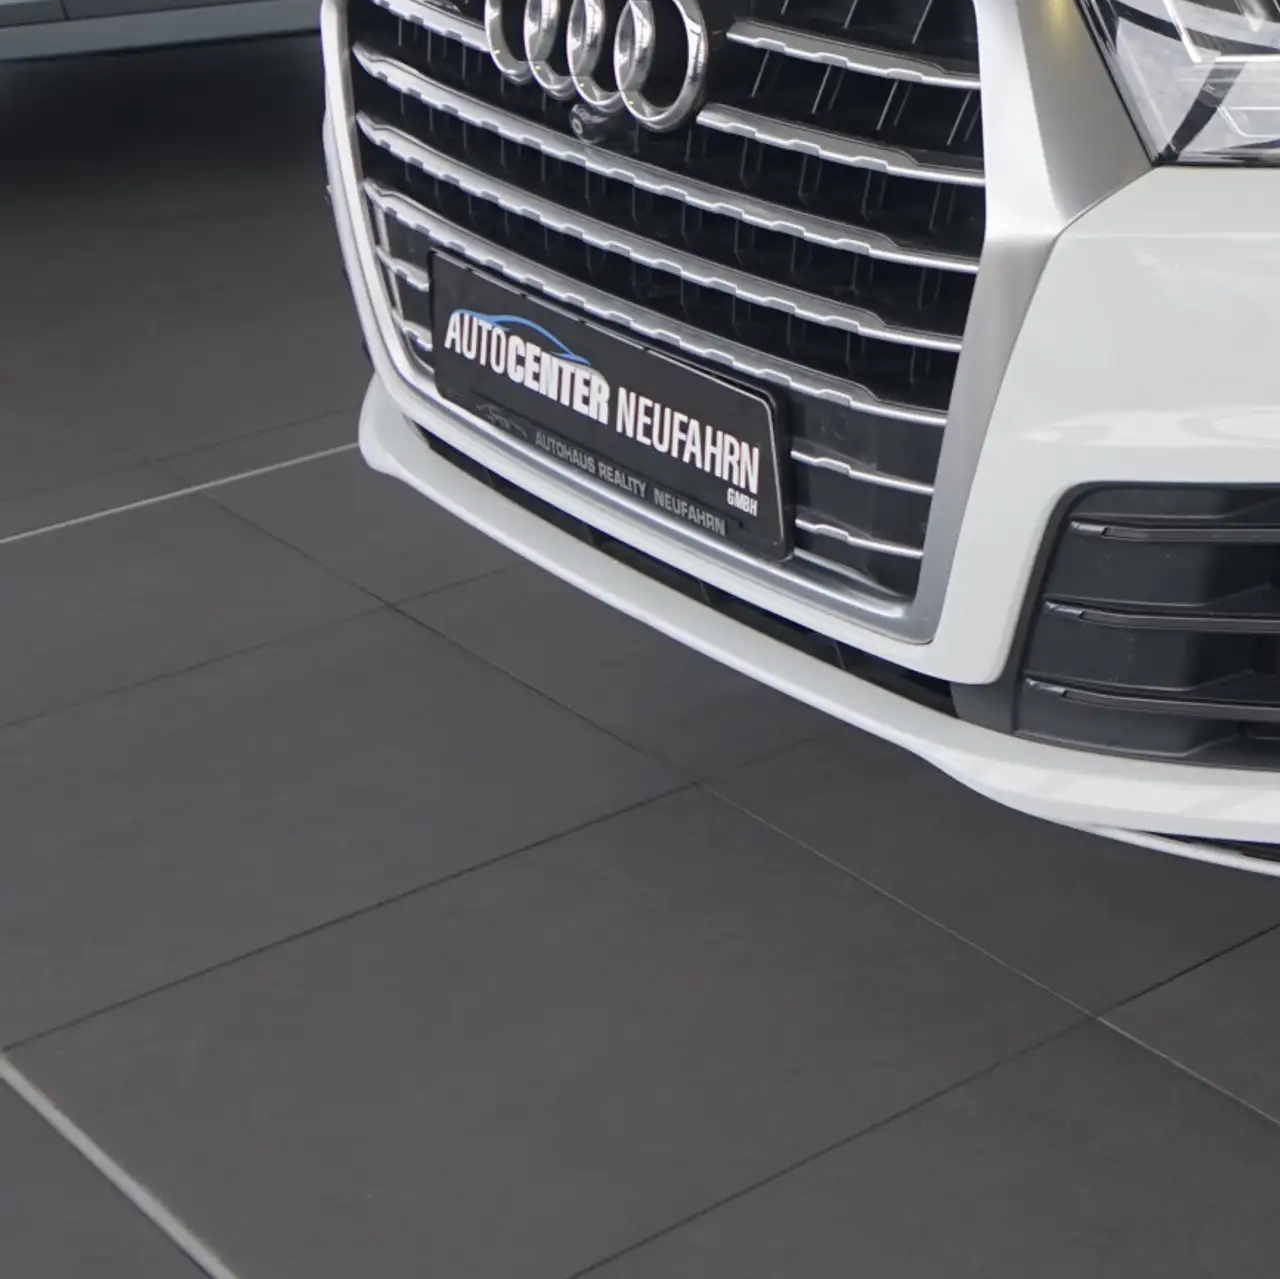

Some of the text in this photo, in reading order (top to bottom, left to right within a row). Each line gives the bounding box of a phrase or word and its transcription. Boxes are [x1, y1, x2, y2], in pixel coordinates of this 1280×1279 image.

[444, 311, 760, 495] AUTOCENTER NEUFAHRN
[535, 431, 726, 536] AUTOHAUS REALITY NEUFAHRN
[726, 487, 758, 517] GMBH
